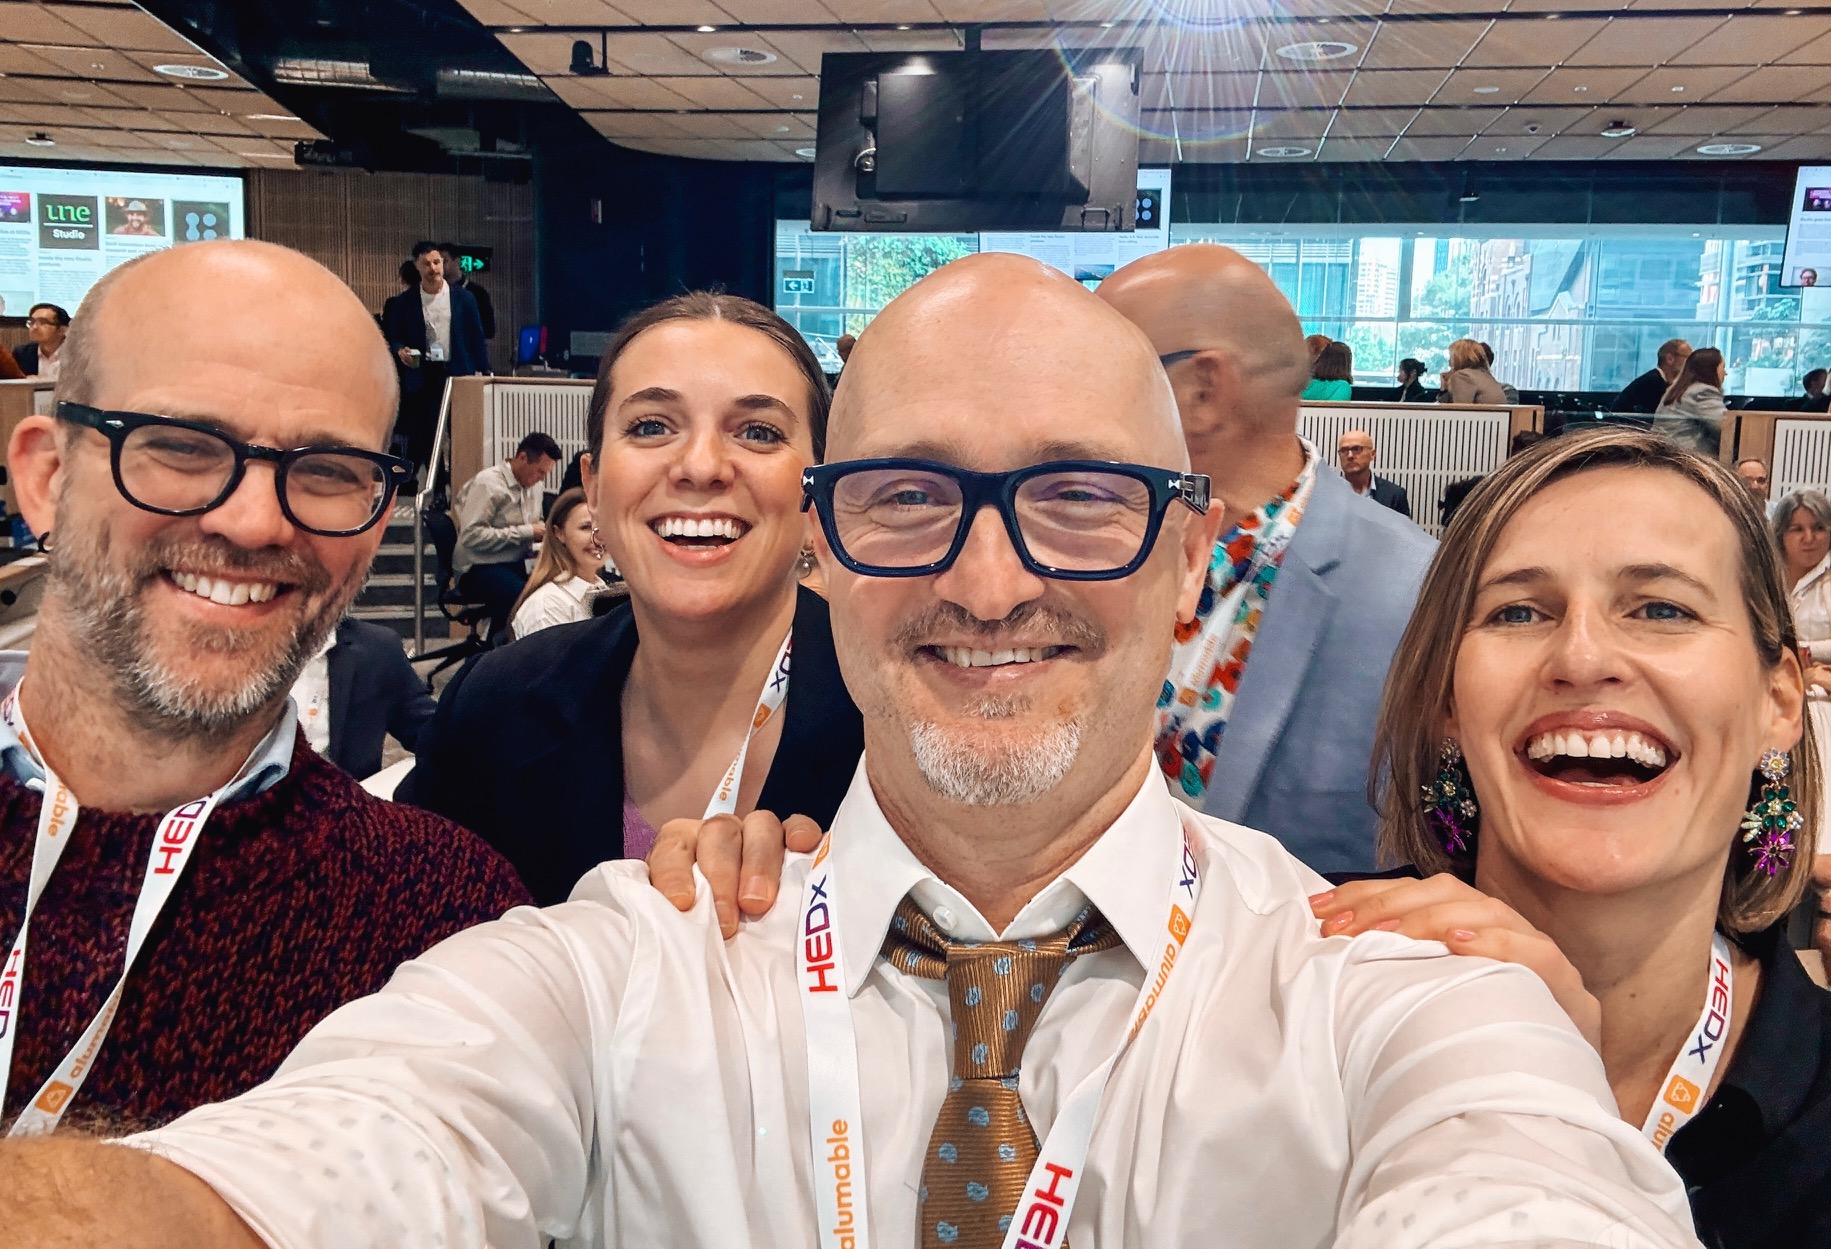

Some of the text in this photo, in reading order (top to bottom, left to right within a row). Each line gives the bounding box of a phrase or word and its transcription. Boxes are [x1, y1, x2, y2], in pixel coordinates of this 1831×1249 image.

[46, 204, 91, 222] une
[52, 228, 85, 240] Studio
[770, 635, 793, 692] DX
[48, 784, 69, 837] able
[153, 793, 212, 874] HED
[1179, 828, 1197, 899] DX
[805, 874, 838, 992] HEDX
[1688, 958, 1729, 1064] HEDX
[826, 1118, 855, 1249] alumable
[1014, 1162, 1073, 1249] HE
